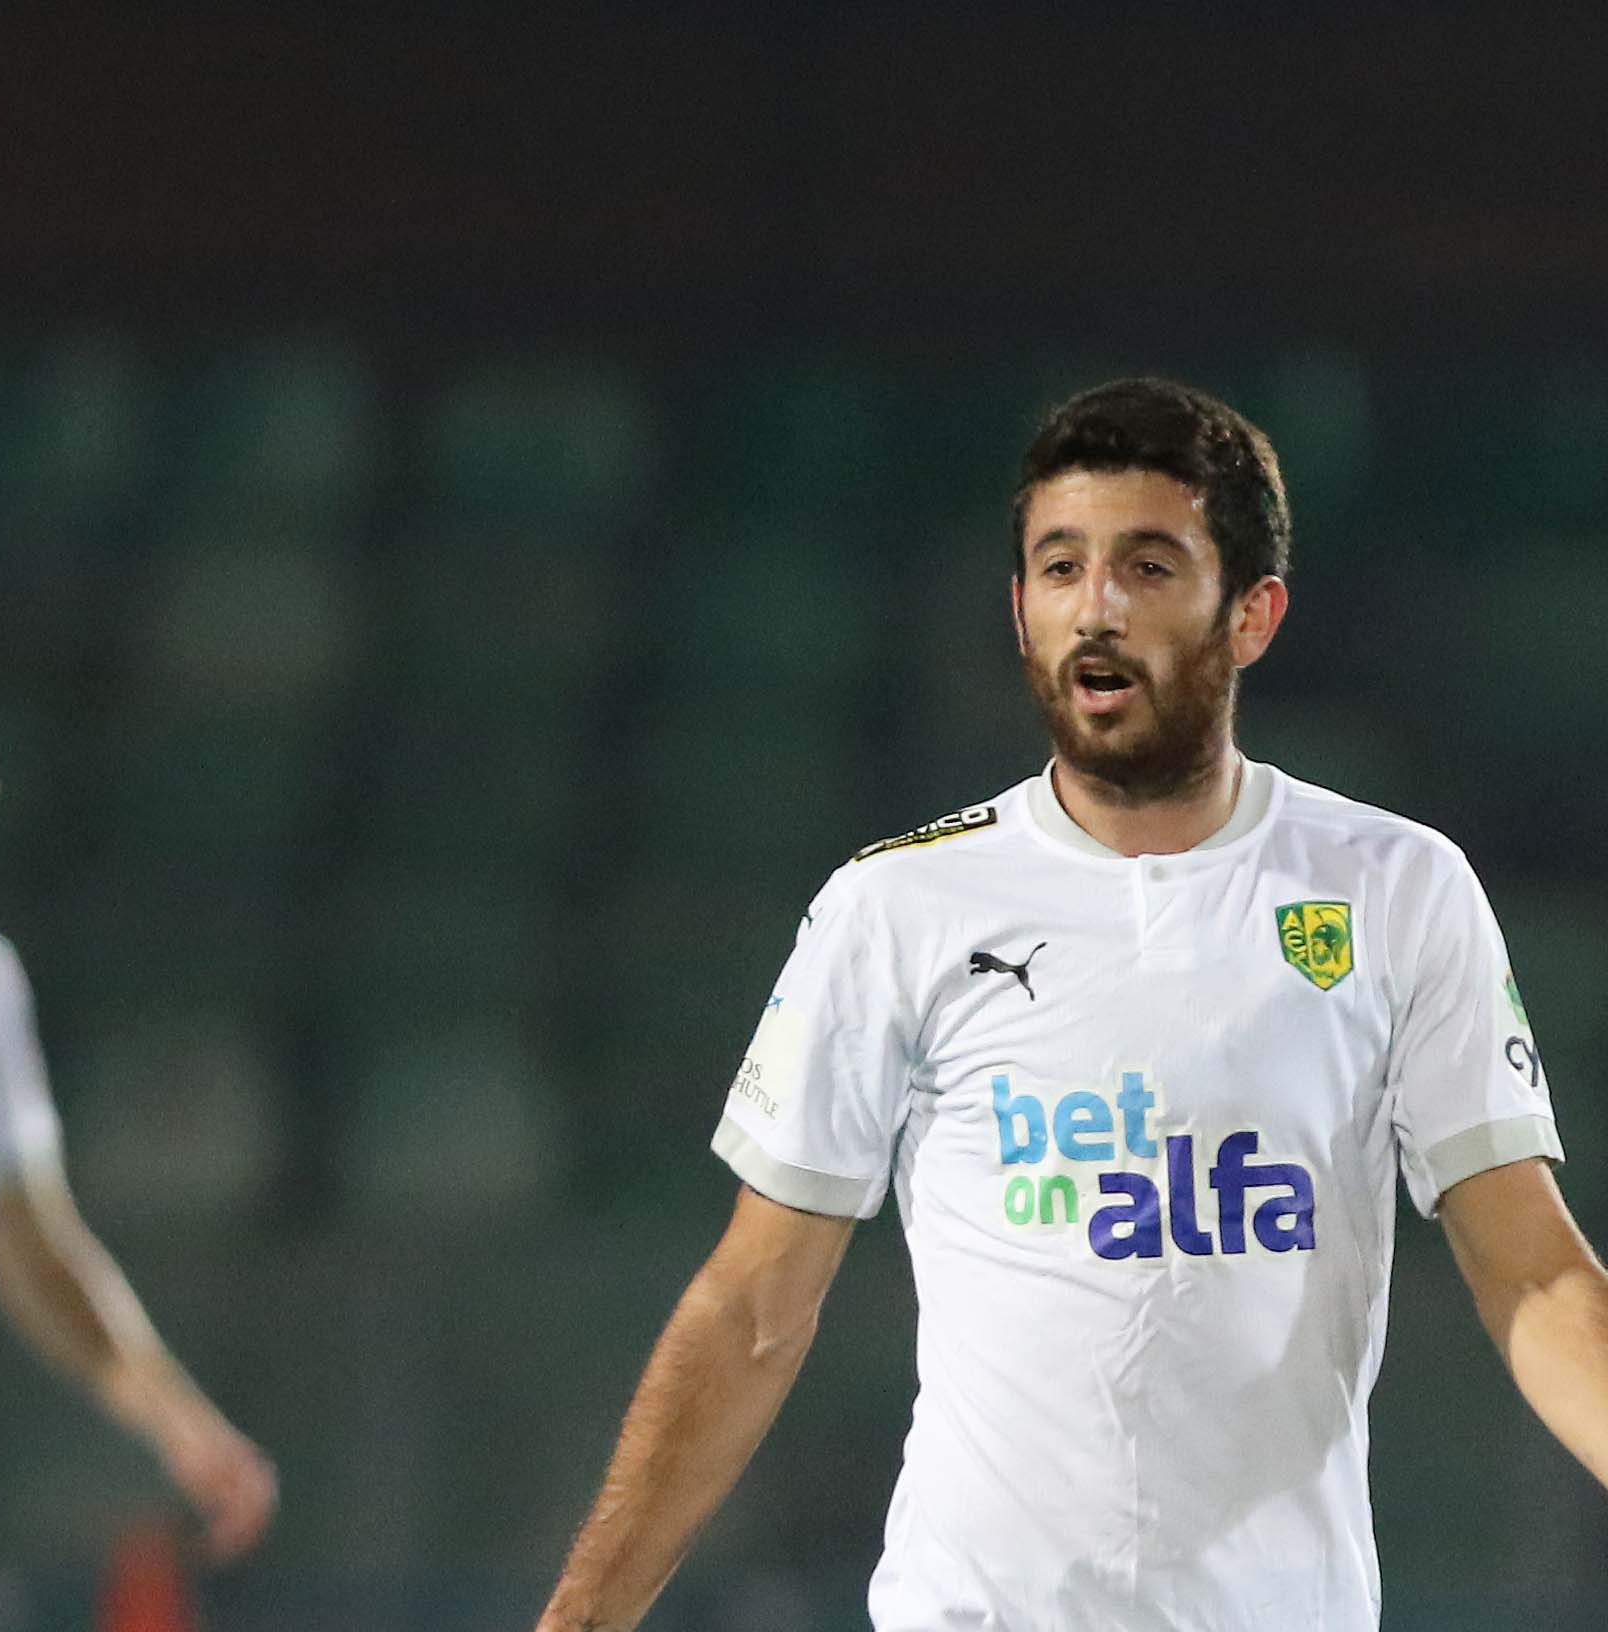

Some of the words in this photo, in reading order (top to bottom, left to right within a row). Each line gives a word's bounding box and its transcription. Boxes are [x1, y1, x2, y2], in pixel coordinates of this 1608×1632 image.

[1505, 1036, 1539, 1088] cy
[992, 1072, 1158, 1165] bet
[1004, 1175, 1080, 1225] on
[1088, 1131, 1316, 1260] alfa
